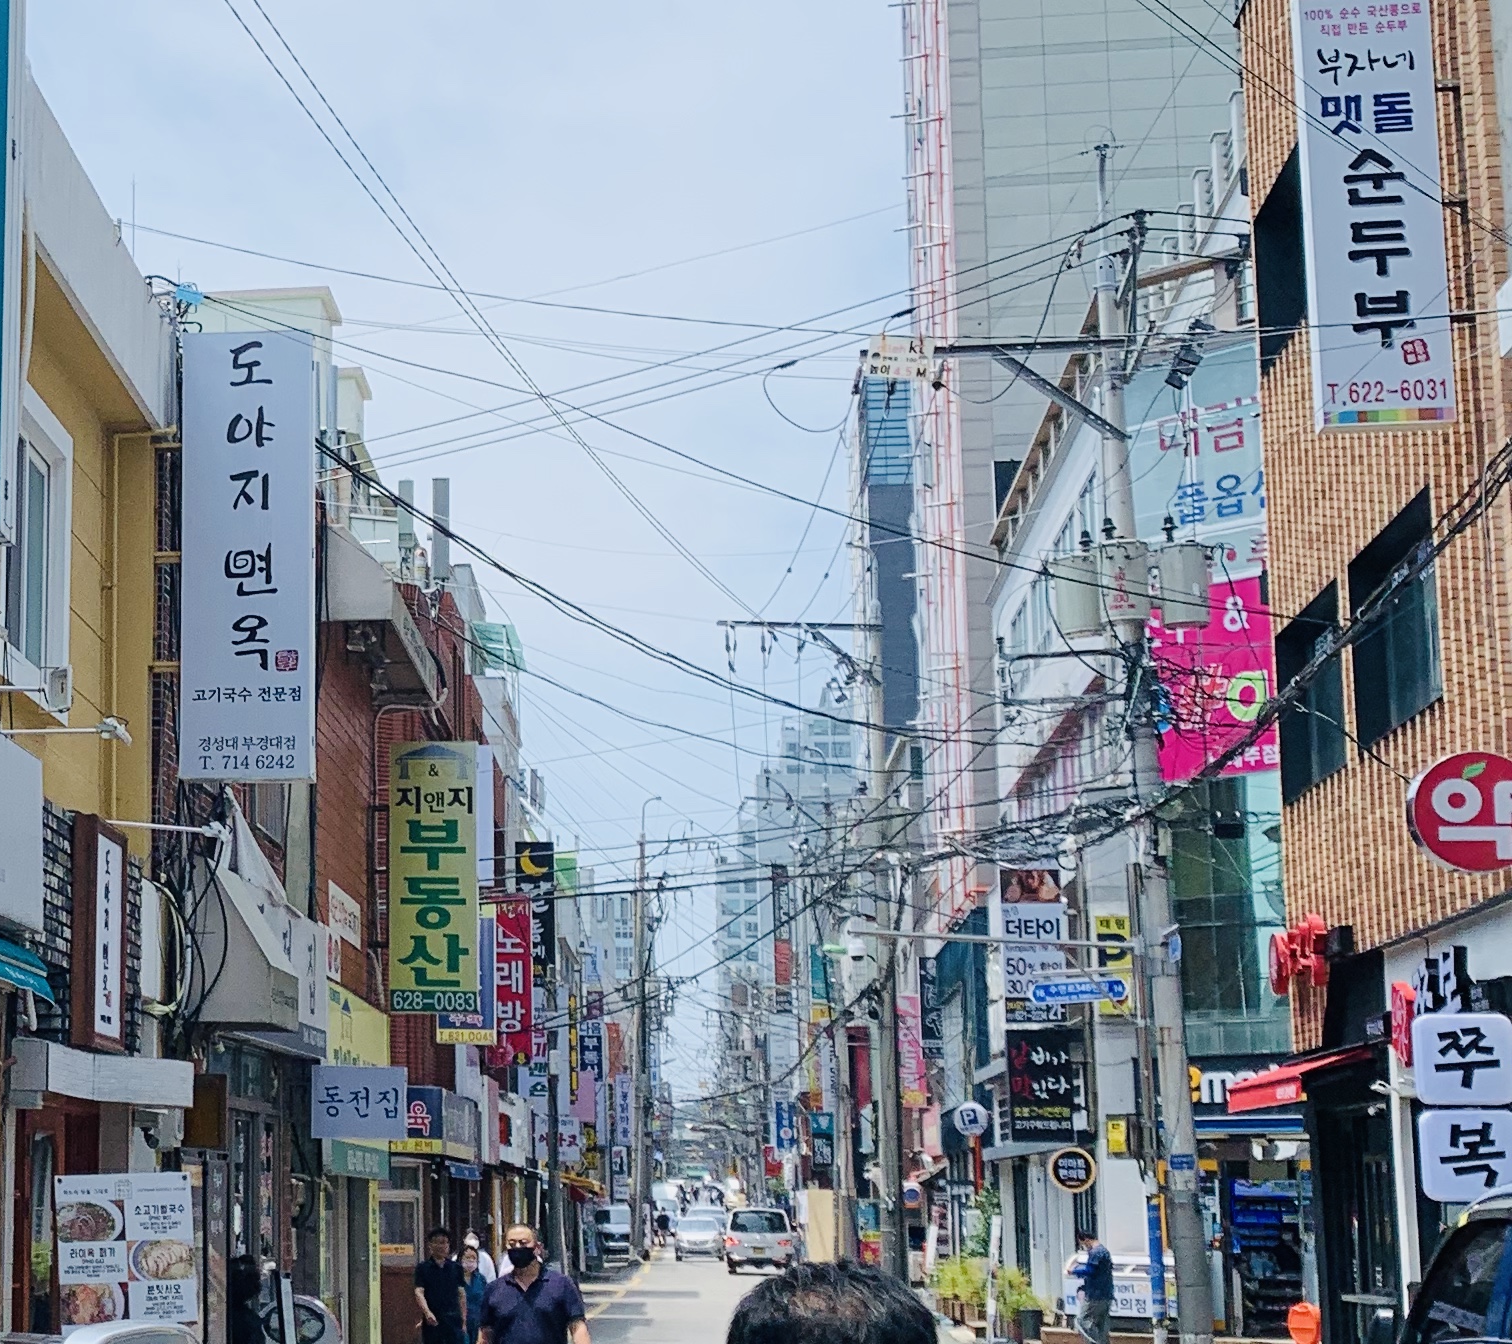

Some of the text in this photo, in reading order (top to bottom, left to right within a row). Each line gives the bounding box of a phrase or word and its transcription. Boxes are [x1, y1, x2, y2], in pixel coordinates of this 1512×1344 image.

[1304, 9, 1333, 21] 100%
[1339, 6, 1361, 20] 순수
[1342, 147, 1413, 350] 순두부
[1327, 379, 1448, 408] T.622-6031
[224, 340, 279, 672] 도야지면옥
[191, 685, 302, 704] 고기국수 전문점
[198, 735, 296, 753] 경성대 부경대점
[222, 754, 251, 771] 714
[255, 753, 296, 770] 6242
[395, 786, 474, 815] 지앤지
[398, 818, 469, 989] 부동산
[1005, 917, 1061, 941] 더타이
[495, 926, 526, 1034] 노래방
[393, 992, 476, 1012] 628-0083
[318, 1086, 400, 1119] 동전집
